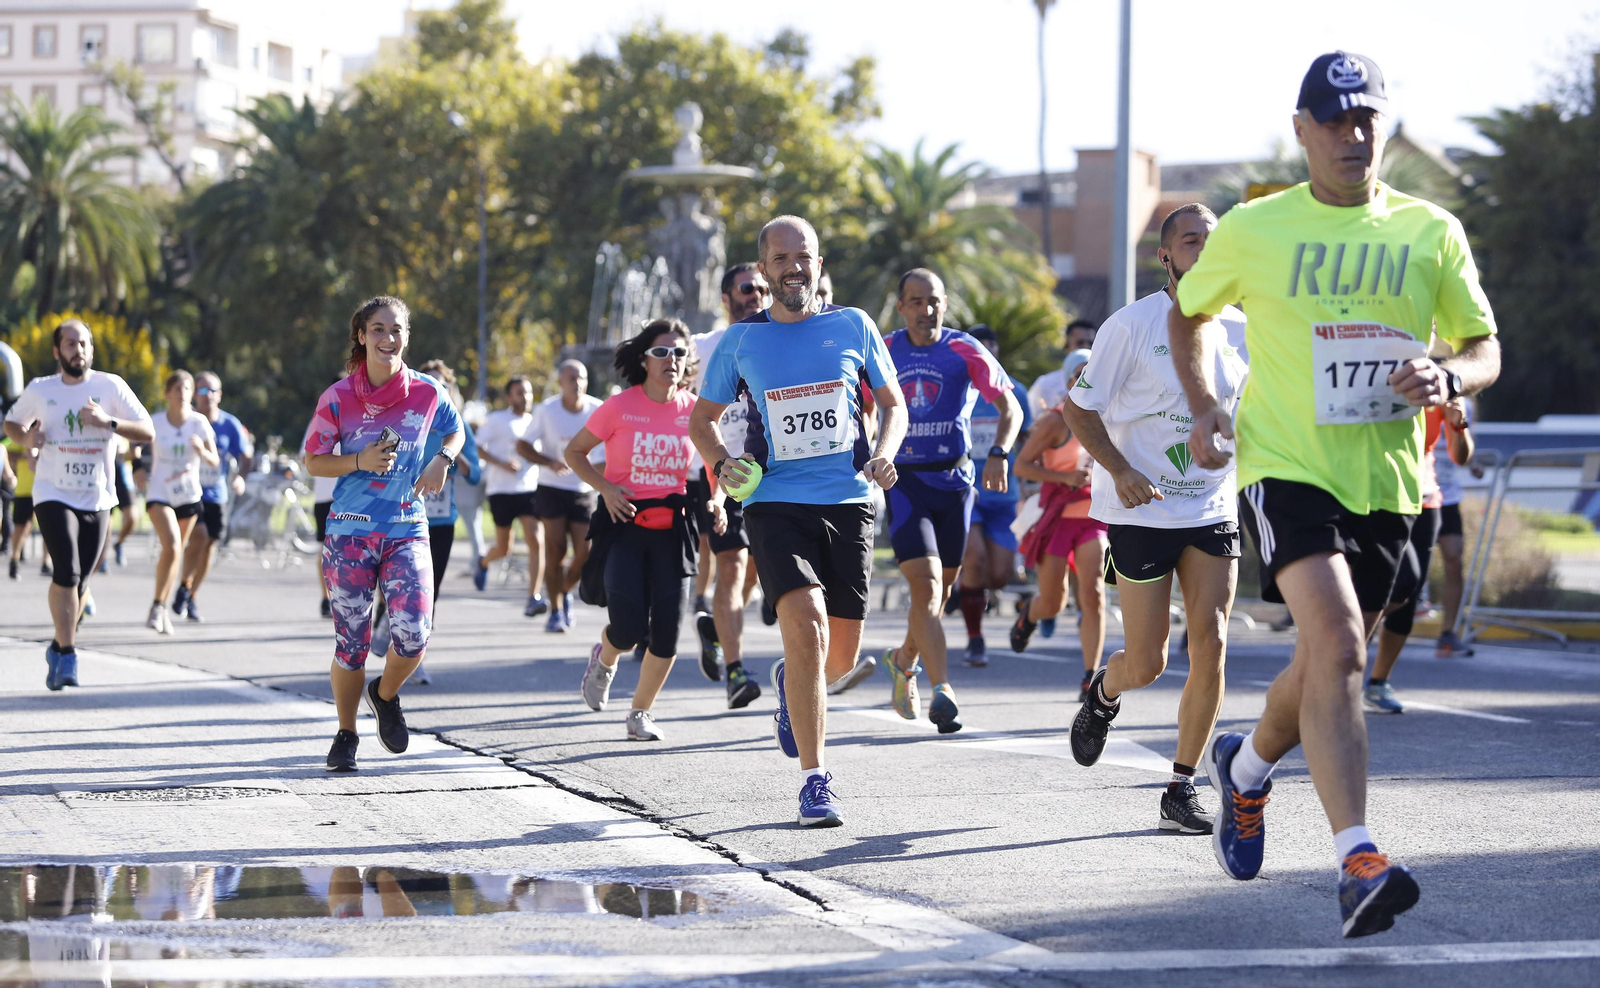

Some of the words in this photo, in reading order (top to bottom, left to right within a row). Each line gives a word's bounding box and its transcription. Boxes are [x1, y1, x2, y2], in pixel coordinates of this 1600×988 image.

[1287, 242, 1410, 297] RUN
[1315, 325, 1335, 340] 41
[1325, 359, 1412, 388] 1777
[767, 390, 781, 401] 41
[781, 385, 814, 394] CARRERA
[815, 381, 844, 389] URBANA
[622, 413, 650, 423] OYSHO
[783, 409, 838, 435] 3786
[1169, 414, 1194, 424] CARRE
[632, 431, 689, 457] HOY
[65, 462, 96, 476] 1537
[631, 454, 687, 470] GANAN
[630, 471, 678, 487] CHICAS
[1160, 475, 1206, 487] Fundación
